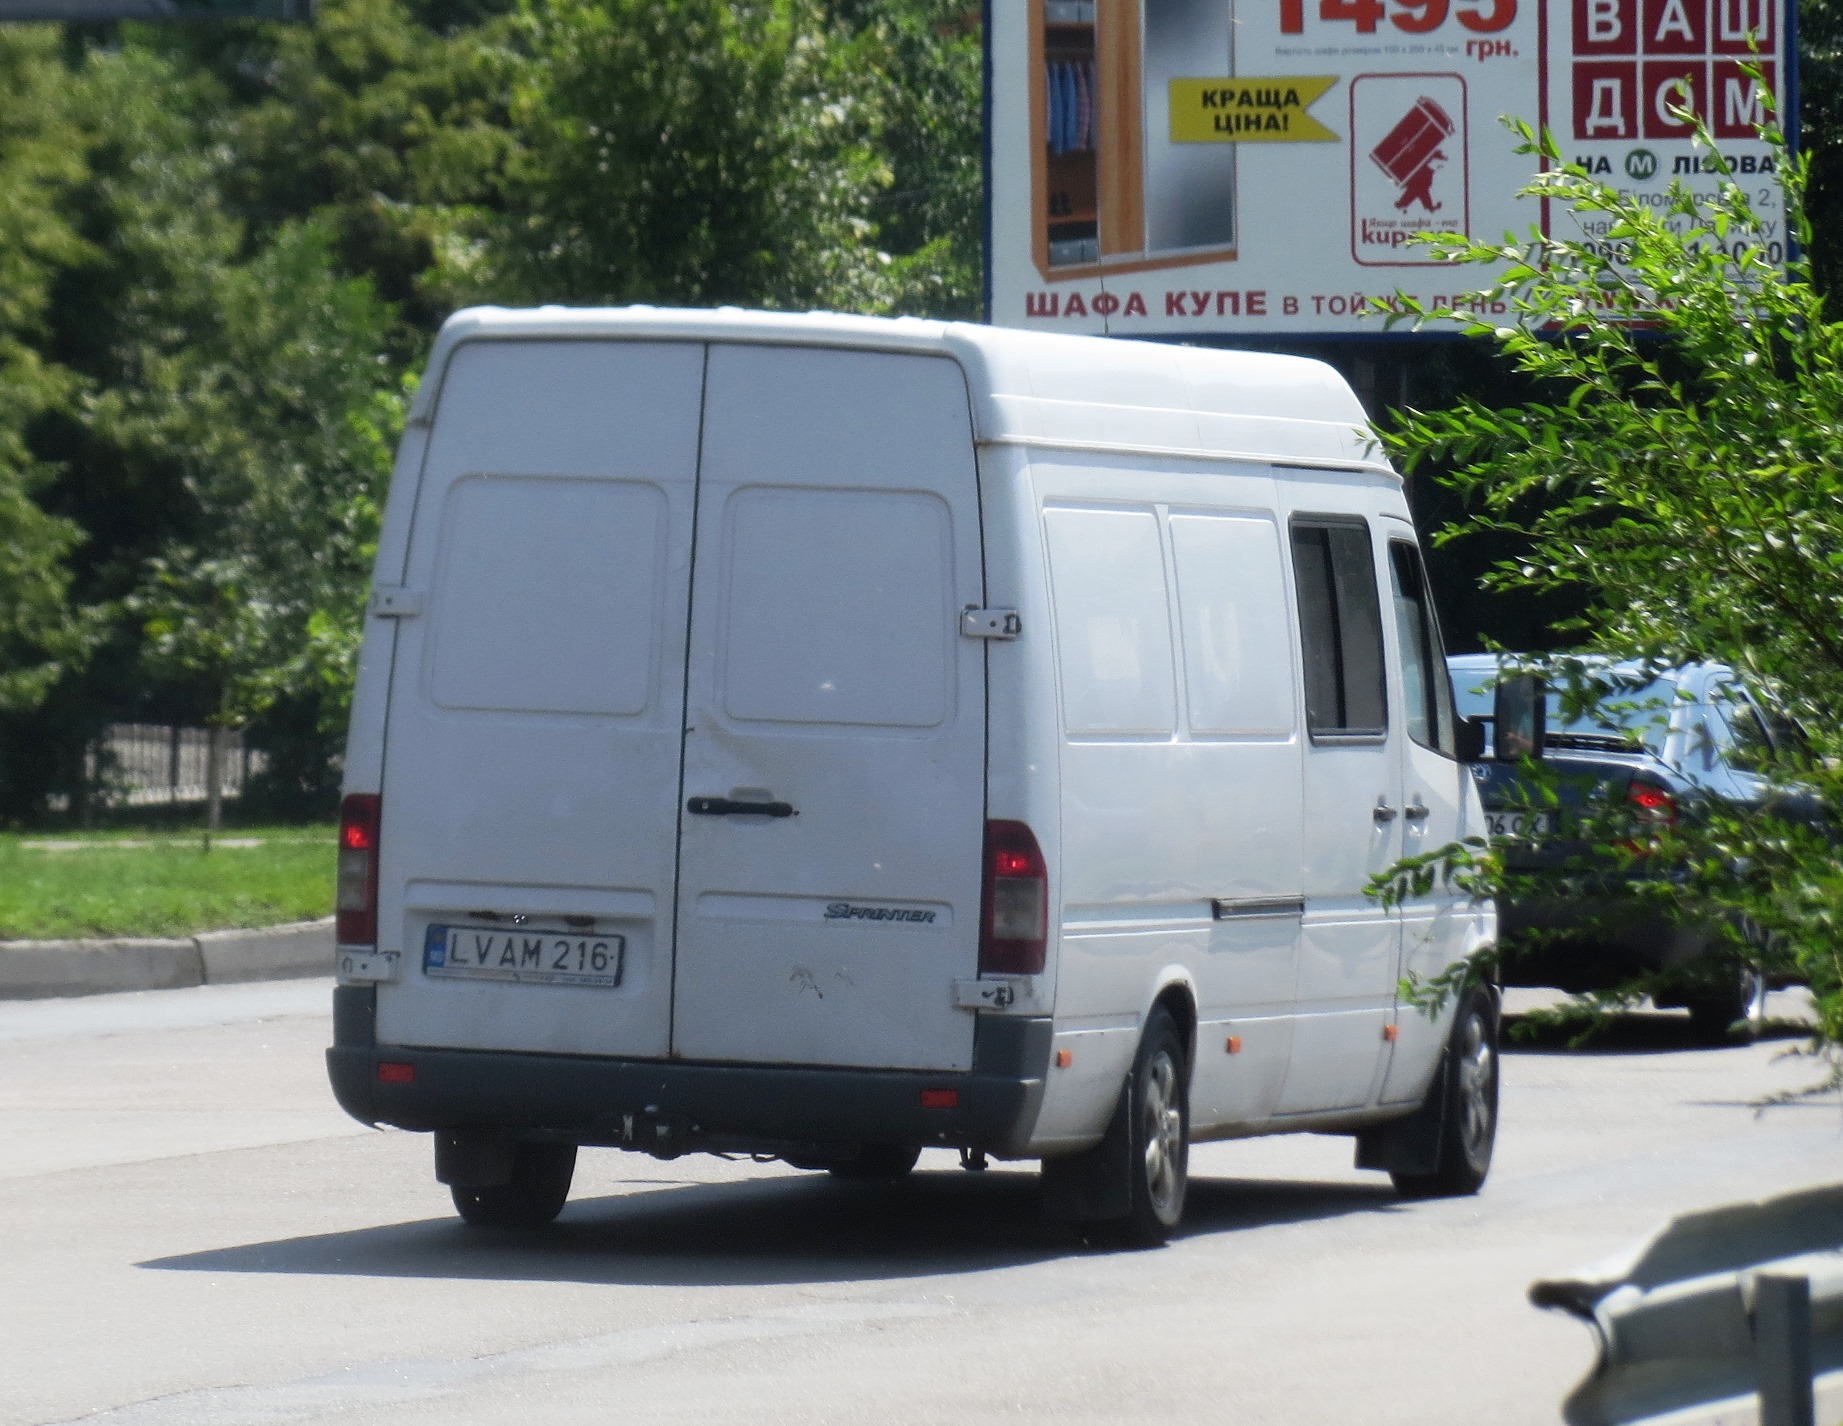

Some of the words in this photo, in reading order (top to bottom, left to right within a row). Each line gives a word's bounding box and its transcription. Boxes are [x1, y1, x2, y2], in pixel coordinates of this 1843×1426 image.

[1466, 39, 1519, 62] грн.
[1202, 88, 1300, 111] КРАЩА
[1585, 77, 1765, 136] ДОМ
[1214, 113, 1290, 135] ЦІНА!
[1575, 155, 1613, 175] НА
[1026, 291, 1148, 317] ШАФА
[1165, 290, 1267, 316] КУПЕ
[1283, 295, 1299, 315] В
[1311, 291, 1367, 316] ТОЙ
[552, 939, 607, 971] 216
